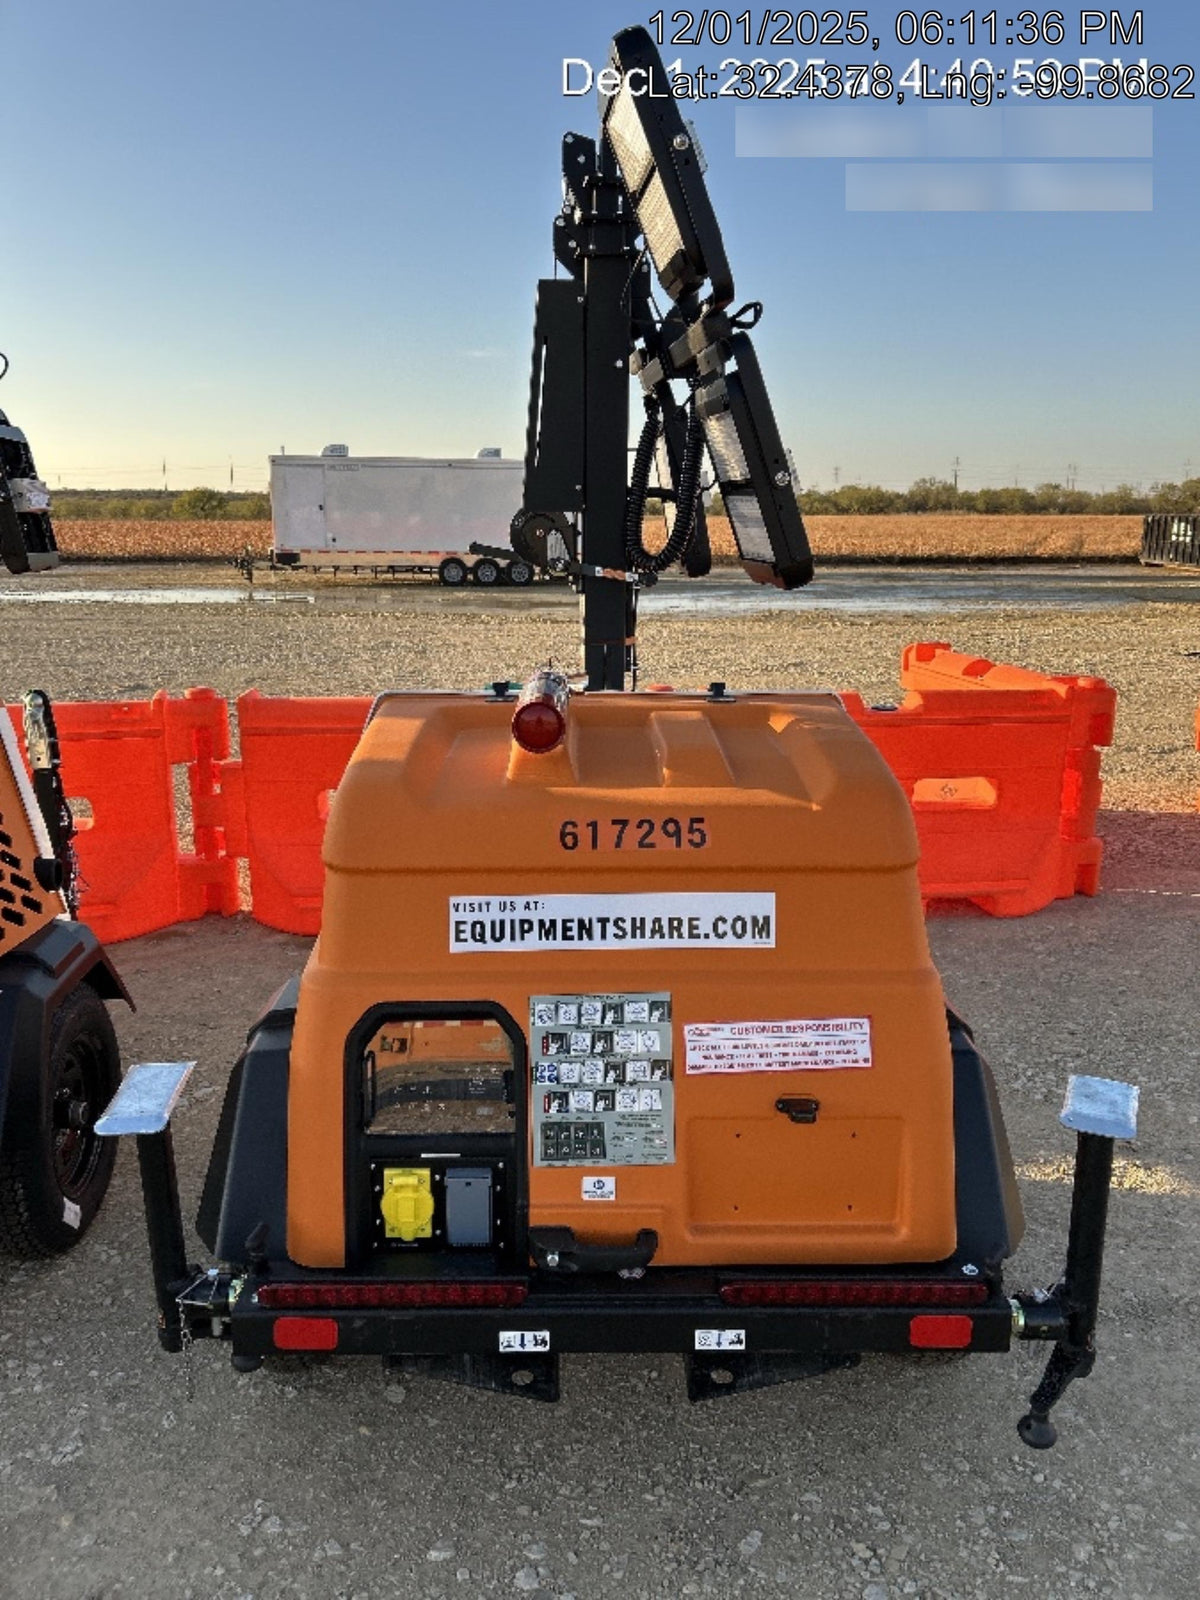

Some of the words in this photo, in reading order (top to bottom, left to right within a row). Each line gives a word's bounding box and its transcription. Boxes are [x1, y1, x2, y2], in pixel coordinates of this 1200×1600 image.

[559, 817, 707, 850] 617295
[452, 901, 492, 913] VISIT
[499, 901, 517, 912] US
[524, 900, 546, 911] AT:
[454, 915, 772, 943] EQUIPMENTSHARE.COM
[730, 1025, 783, 1036] CUSTOMER
[785, 1021, 865, 1034] RESPONSIBILITY
